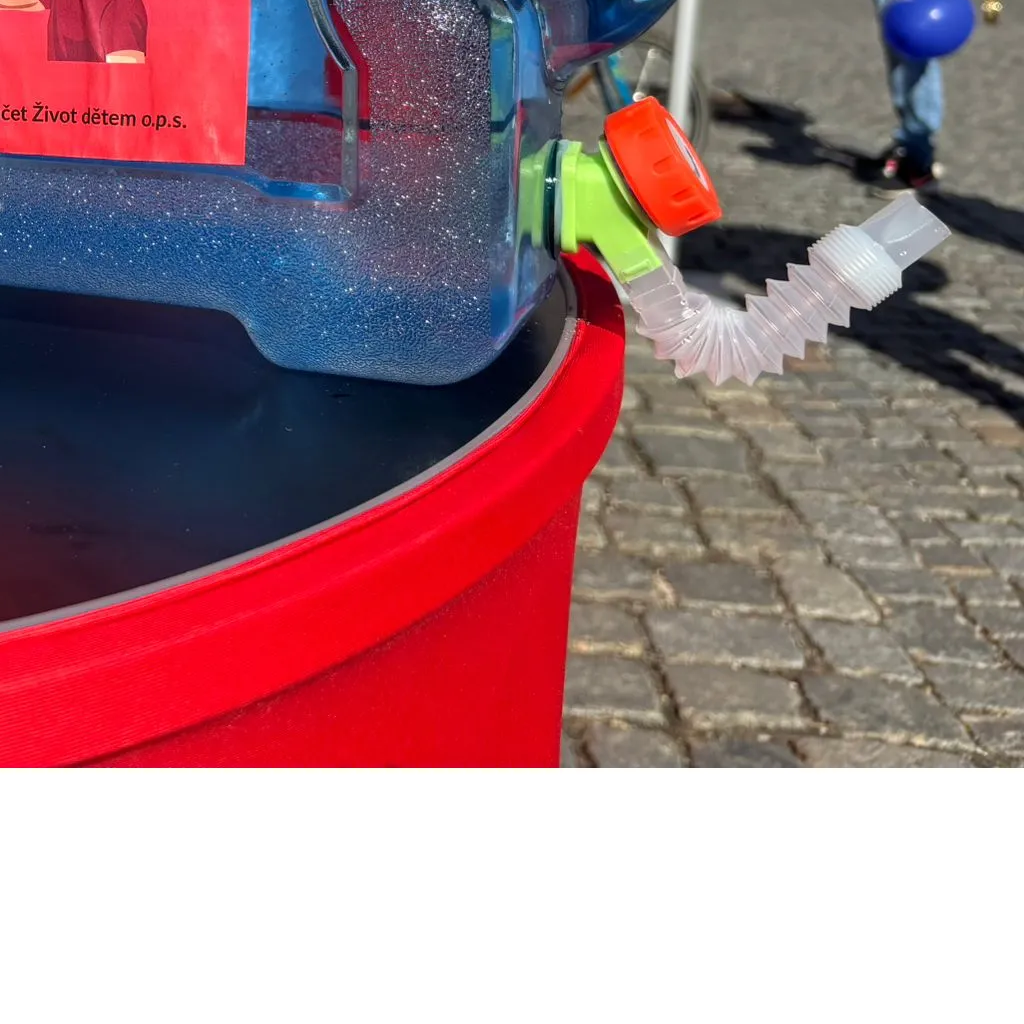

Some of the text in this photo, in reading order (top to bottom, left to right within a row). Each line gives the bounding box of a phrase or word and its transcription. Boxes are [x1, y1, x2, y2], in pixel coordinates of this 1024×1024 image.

[32, 102, 78, 123] Život
[81, 107, 137, 127] dětem
[141, 113, 188, 131] o.p.s.
